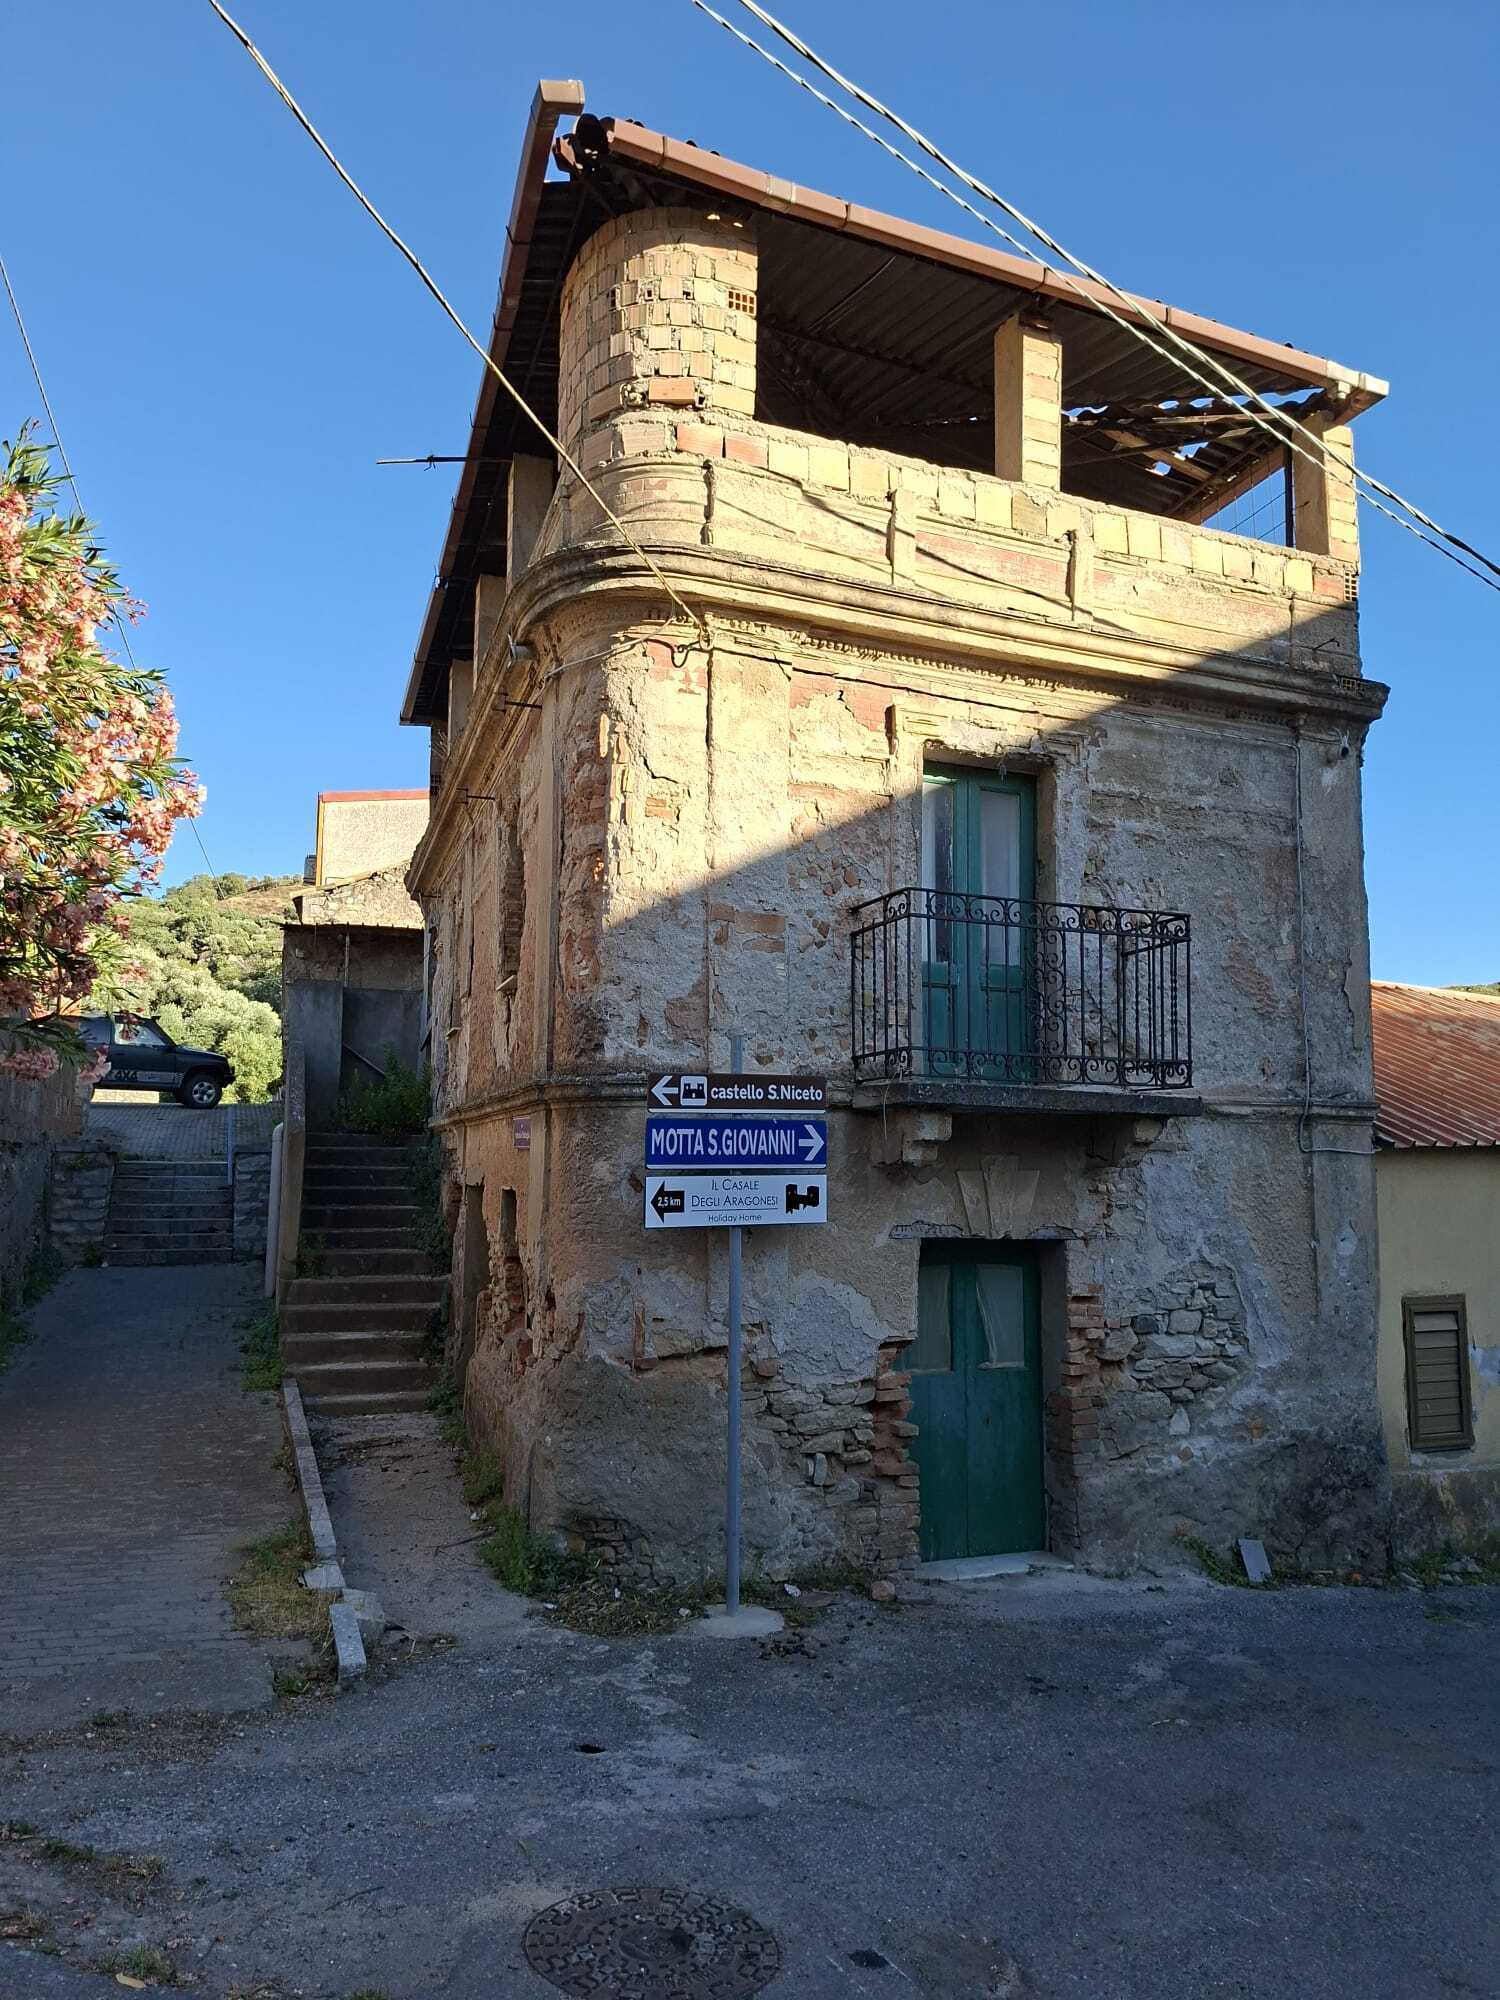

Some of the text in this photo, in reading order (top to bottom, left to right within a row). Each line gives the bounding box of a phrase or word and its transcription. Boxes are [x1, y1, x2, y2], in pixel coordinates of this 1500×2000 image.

[711, 1085, 823, 1101] castello S.Niceto
[651, 1128, 795, 1155] MOTTA S.GIOVANNI
[722, 1179, 759, 1190] CASALE
[692, 1195, 778, 1207] DEGLI ARAGONESI
[709, 1214, 737, 1222] Holiday
